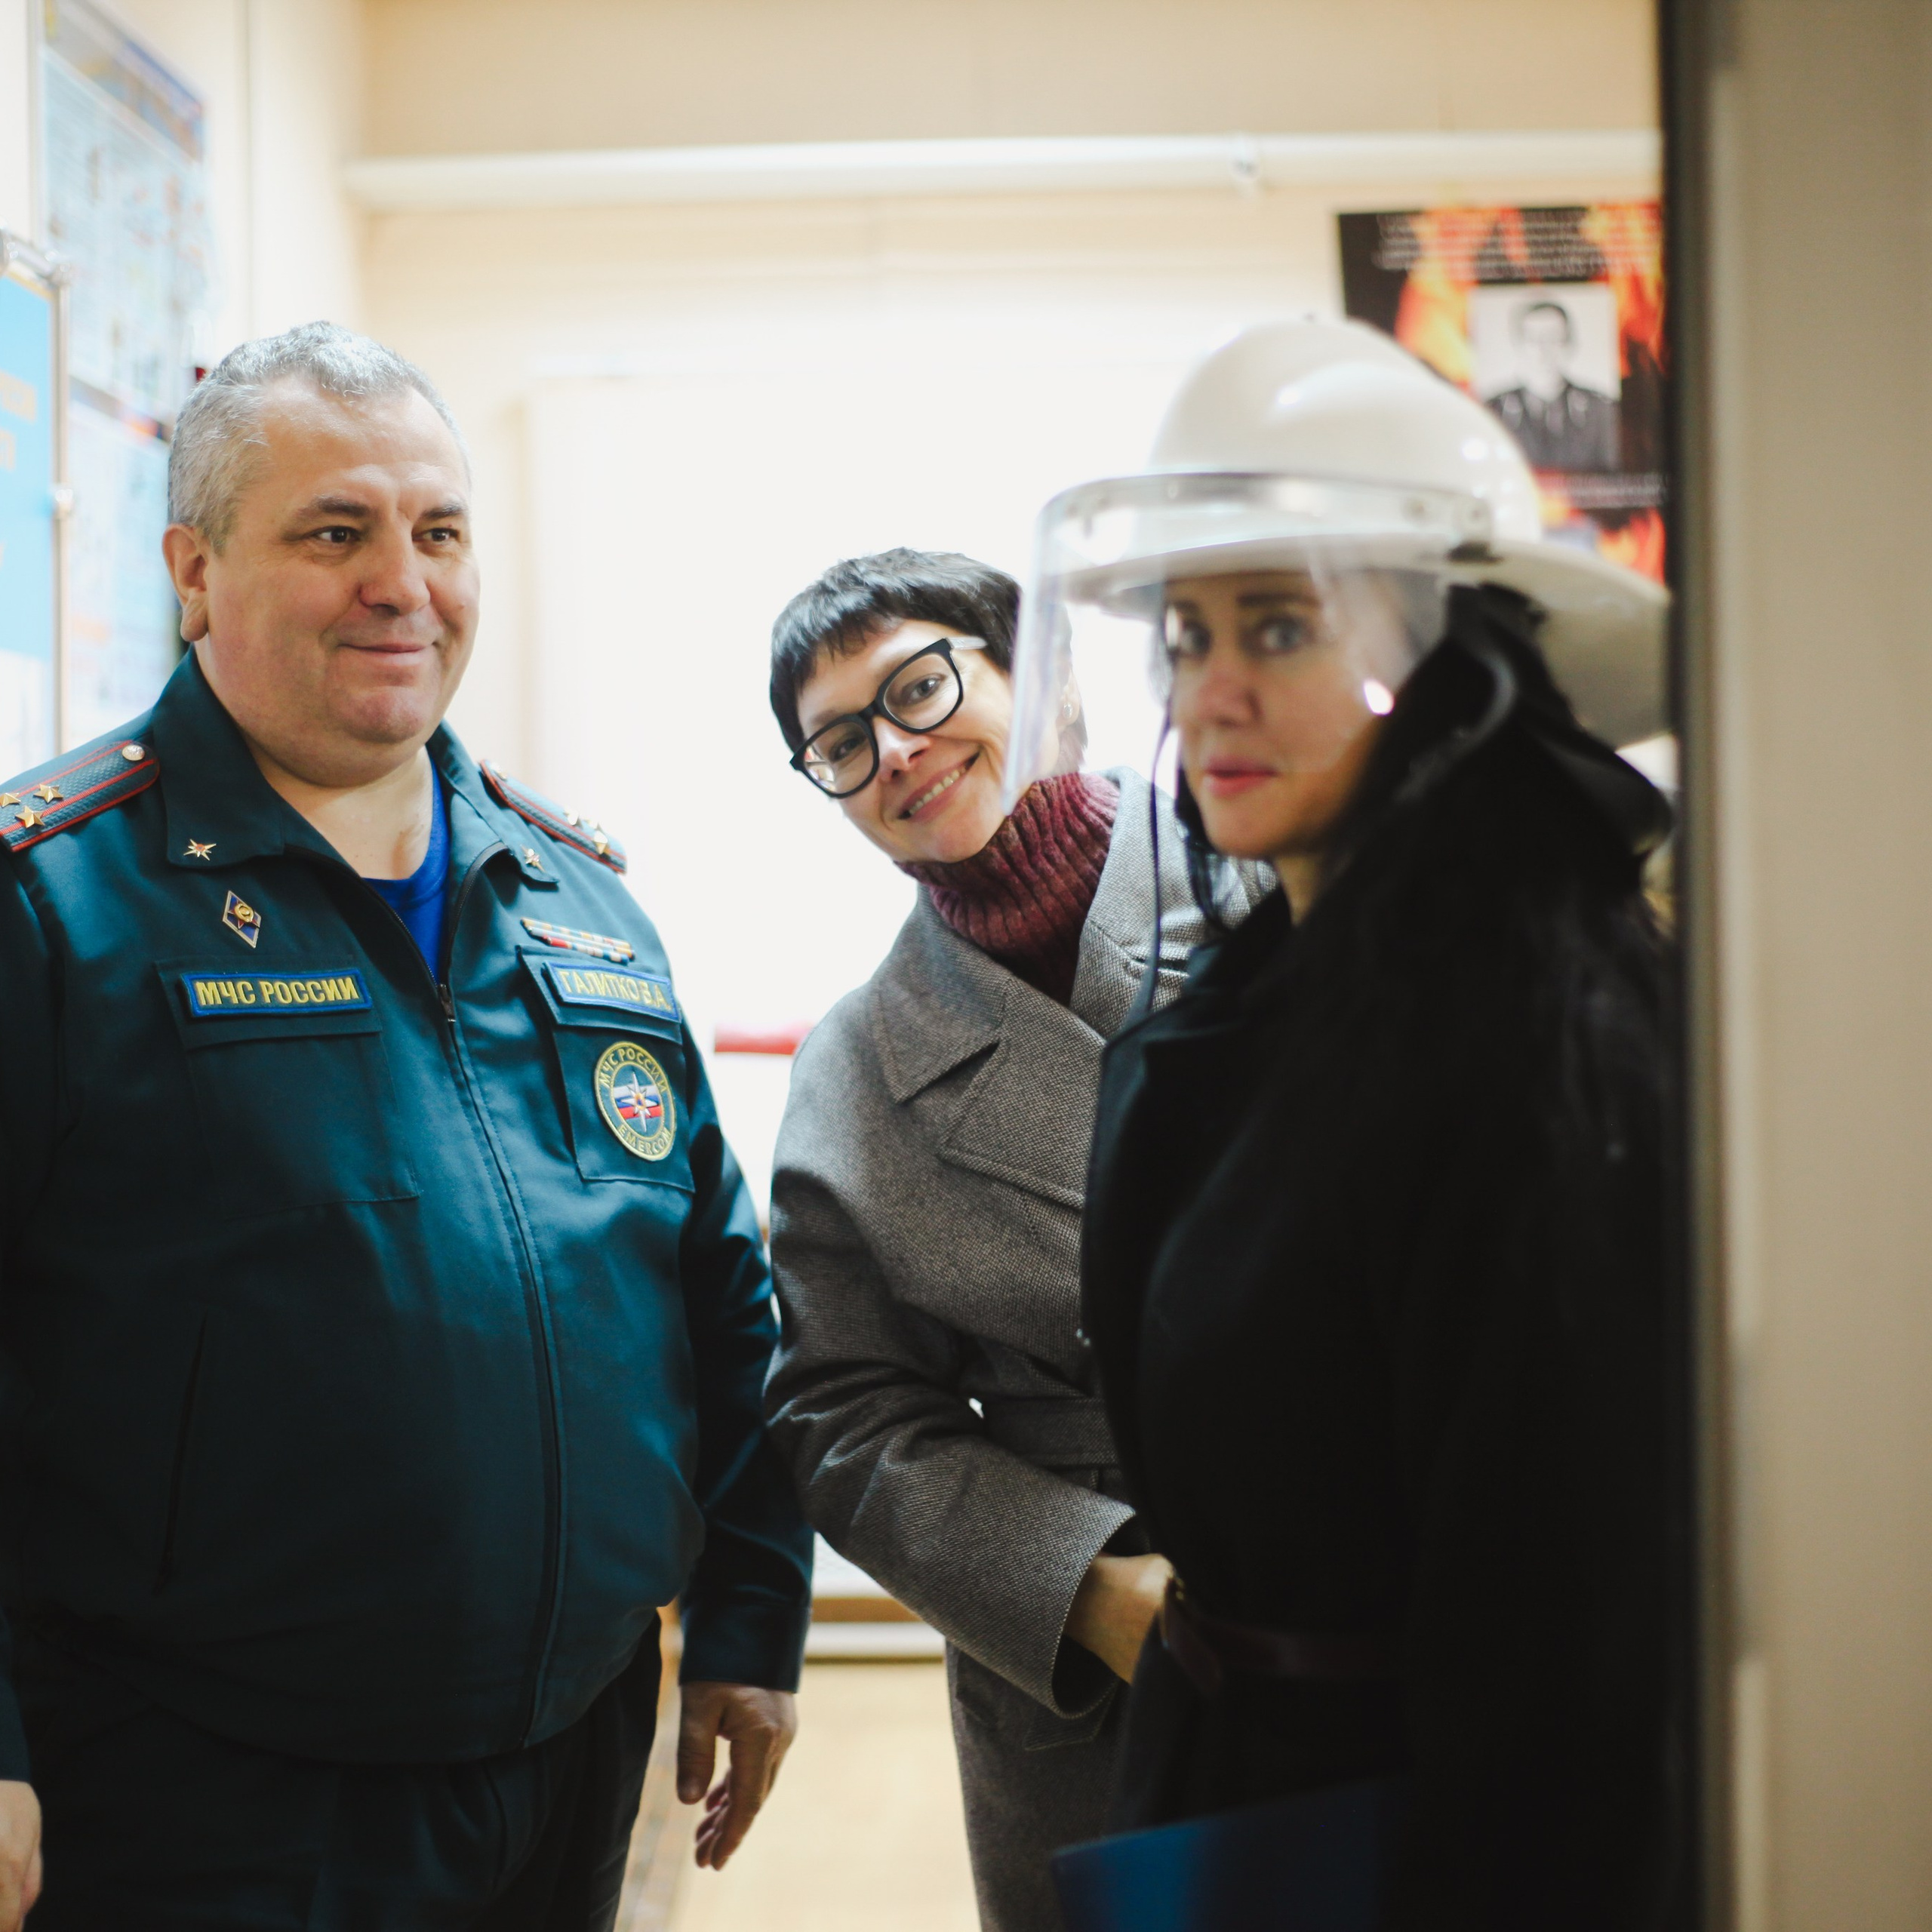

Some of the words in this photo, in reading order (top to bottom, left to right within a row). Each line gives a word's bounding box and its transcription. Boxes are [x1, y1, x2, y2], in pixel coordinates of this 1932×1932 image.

[195, 980, 257, 1006] МЧС
[259, 977, 359, 1004] РОССИИ
[598, 1053, 619, 1088] МЧС
[617, 1048, 668, 1093] РОССИИ
[618, 1124, 672, 1155] EMERCOM
